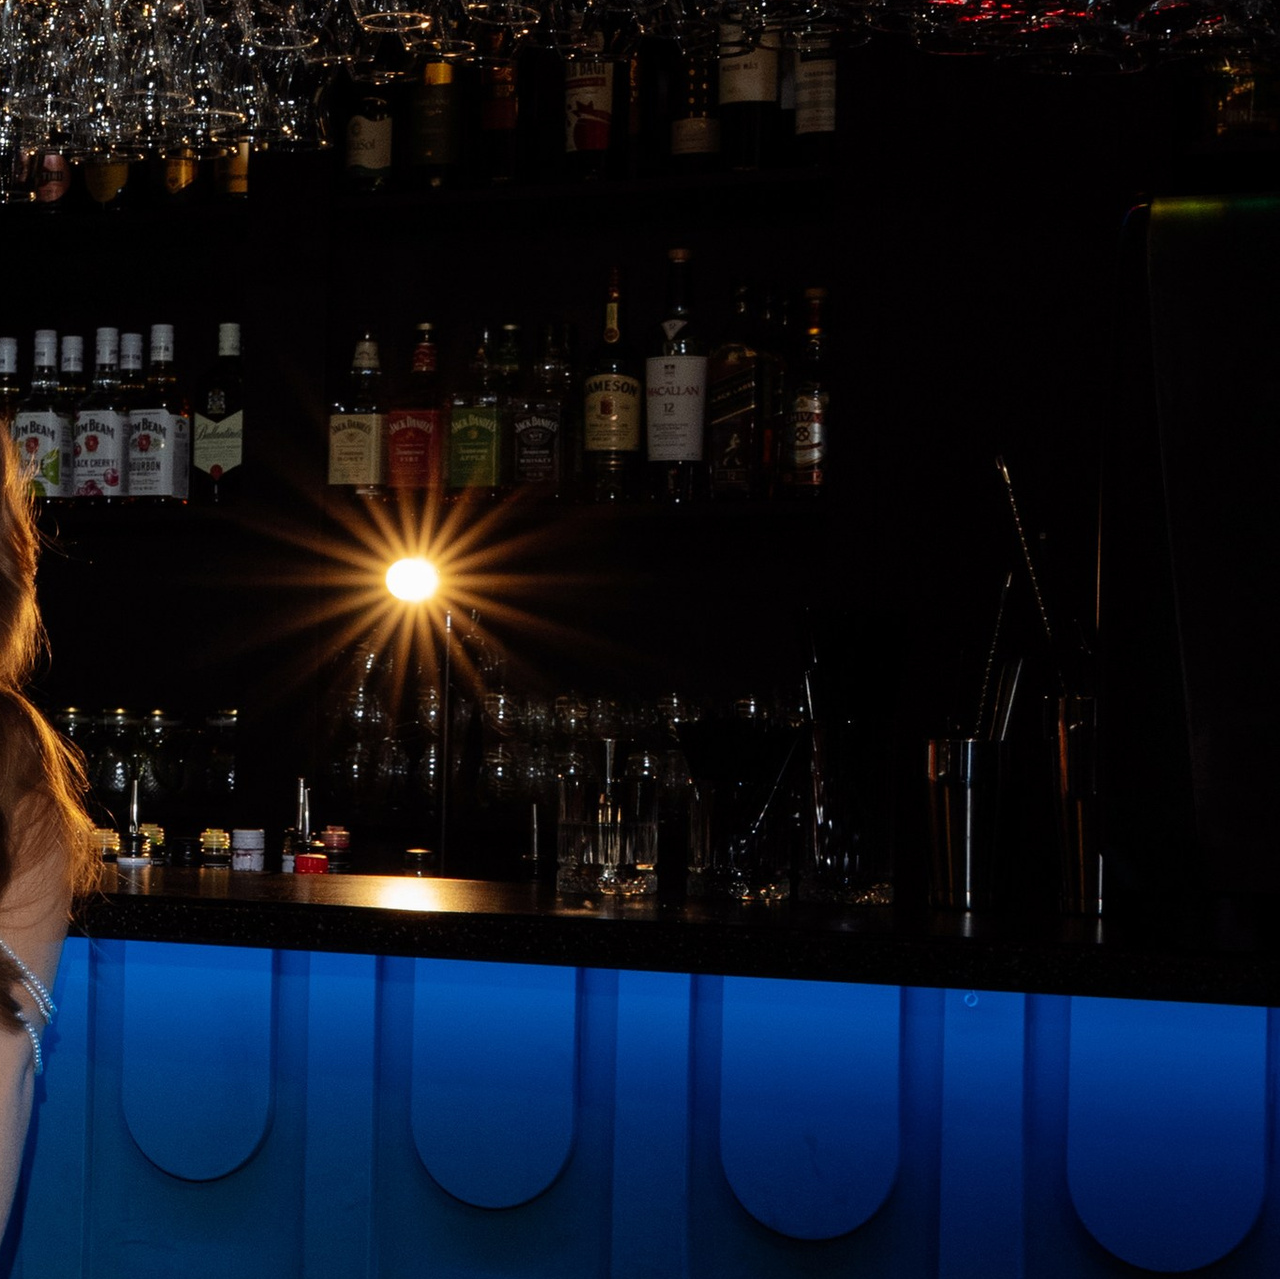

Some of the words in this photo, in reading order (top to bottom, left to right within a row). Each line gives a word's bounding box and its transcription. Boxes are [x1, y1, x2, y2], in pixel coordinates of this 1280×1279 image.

[663, 403, 675, 413] 12
[29, 420, 56, 441] BEAM
[89, 418, 115, 439] BEAM
[142, 418, 167, 438] BEAM
